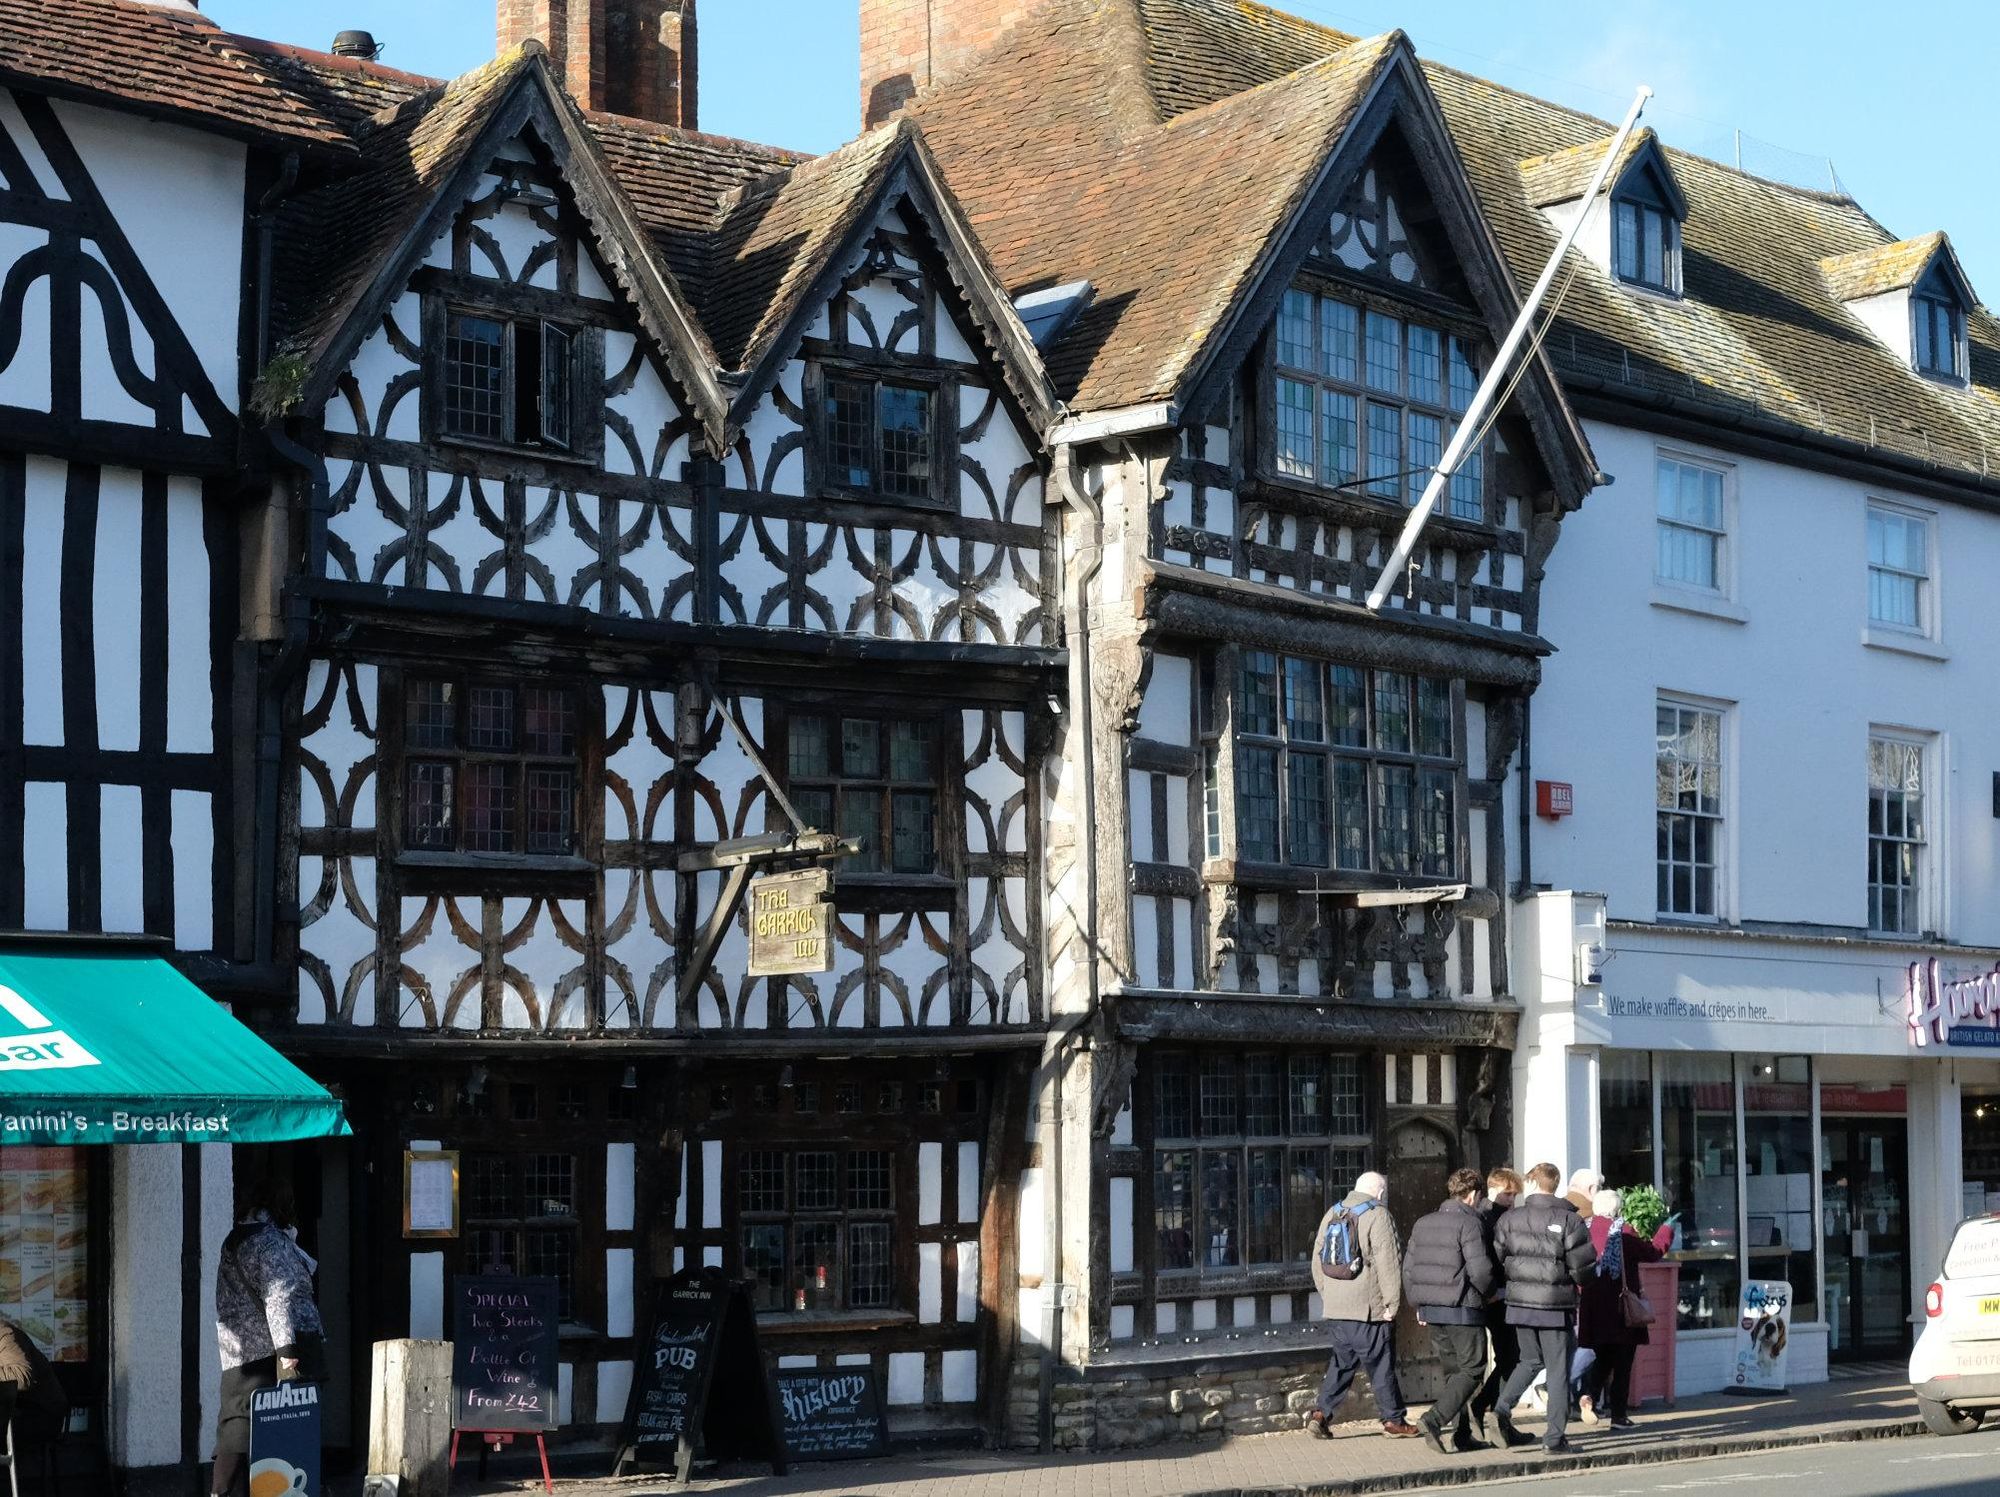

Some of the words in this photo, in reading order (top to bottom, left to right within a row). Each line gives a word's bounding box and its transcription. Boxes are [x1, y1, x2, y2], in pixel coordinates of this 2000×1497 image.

[1609, 995, 1625, 1014] We
[1627, 1000, 1652, 1016] make
[1654, 997, 1688, 1017] waffles
[1689, 1000, 1707, 1018] and
[1737, 1002, 1746, 1018] in
[112, 1112, 229, 1132] Breakfast
[688, 1281, 701, 1289] THE
[699, 1291, 712, 1300] INN
[655, 1347, 697, 1370] PUB
[486, 1368, 521, 1383] Wine
[254, 1382, 318, 1411] LAVAZZA
[468, 1387, 503, 1407] From
[505, 1393, 540, 1410] £42
